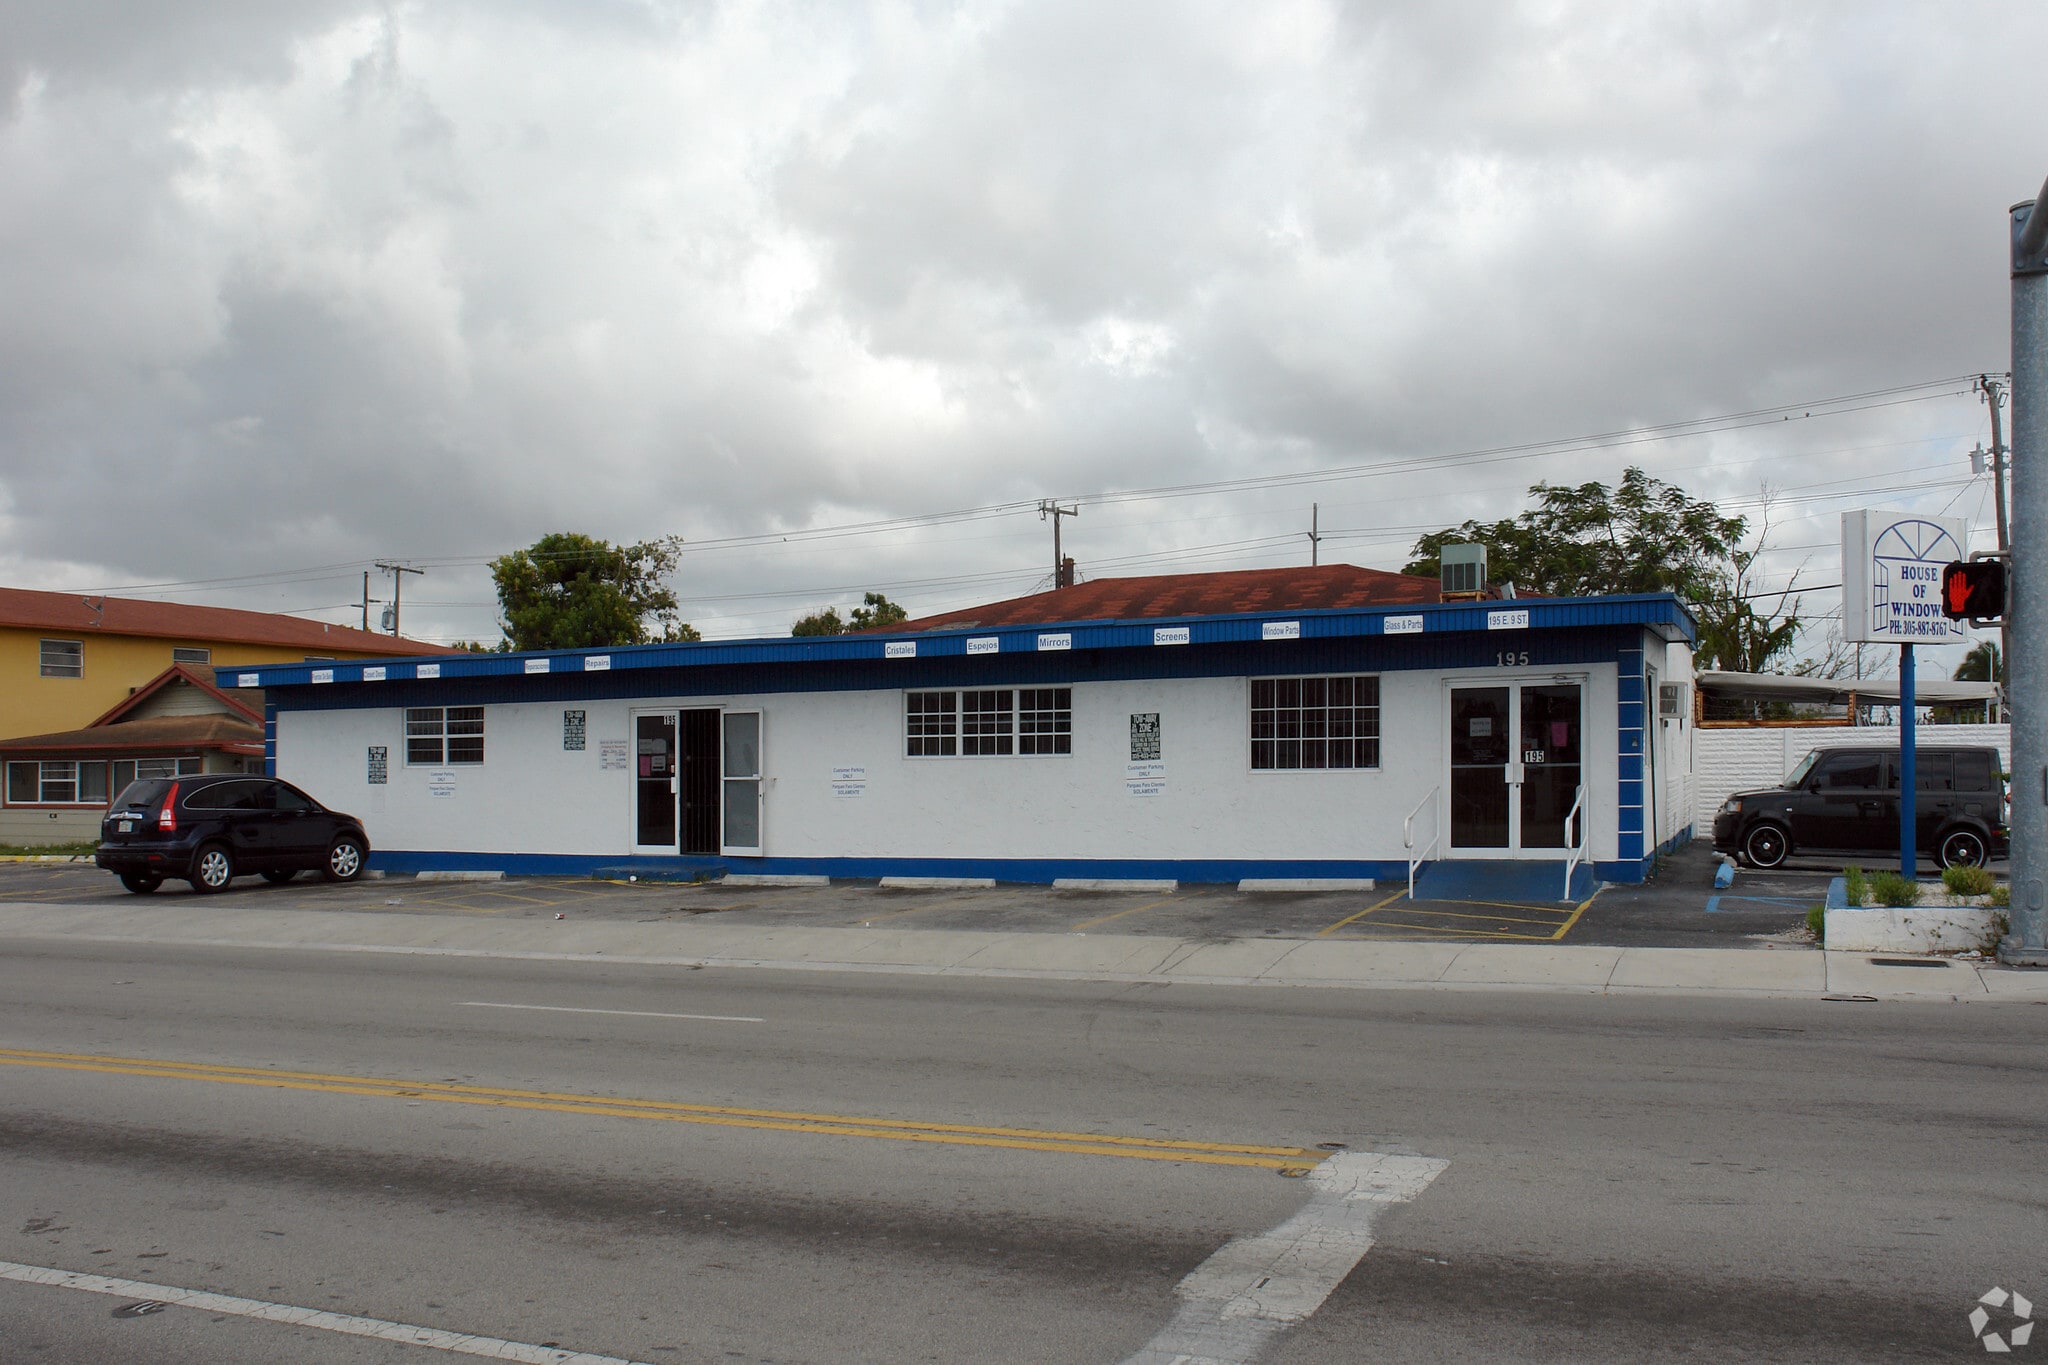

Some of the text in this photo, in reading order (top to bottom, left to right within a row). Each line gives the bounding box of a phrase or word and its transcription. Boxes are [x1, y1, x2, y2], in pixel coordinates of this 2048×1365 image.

[1901, 566, 1938, 581] HOUSE
[1913, 584, 1926, 598] OF
[1891, 602, 1945, 618] WINDOW
[1384, 619, 1423, 630] Glass & Parts
[1489, 614, 1528, 625] 195 E. 9 ST.
[1263, 625, 1299, 636] Window Parts
[1889, 620, 1947, 636] PH: 305-887-8767
[1039, 637, 1071, 648] Mirrors
[1155, 632, 1188, 642] Screens
[886, 646, 915, 655] Cristales
[968, 641, 998, 652] Espejos
[585, 660, 609, 669] Repairs
[1496, 651, 1529, 667] 195
[1526, 751, 1544, 762] 195
